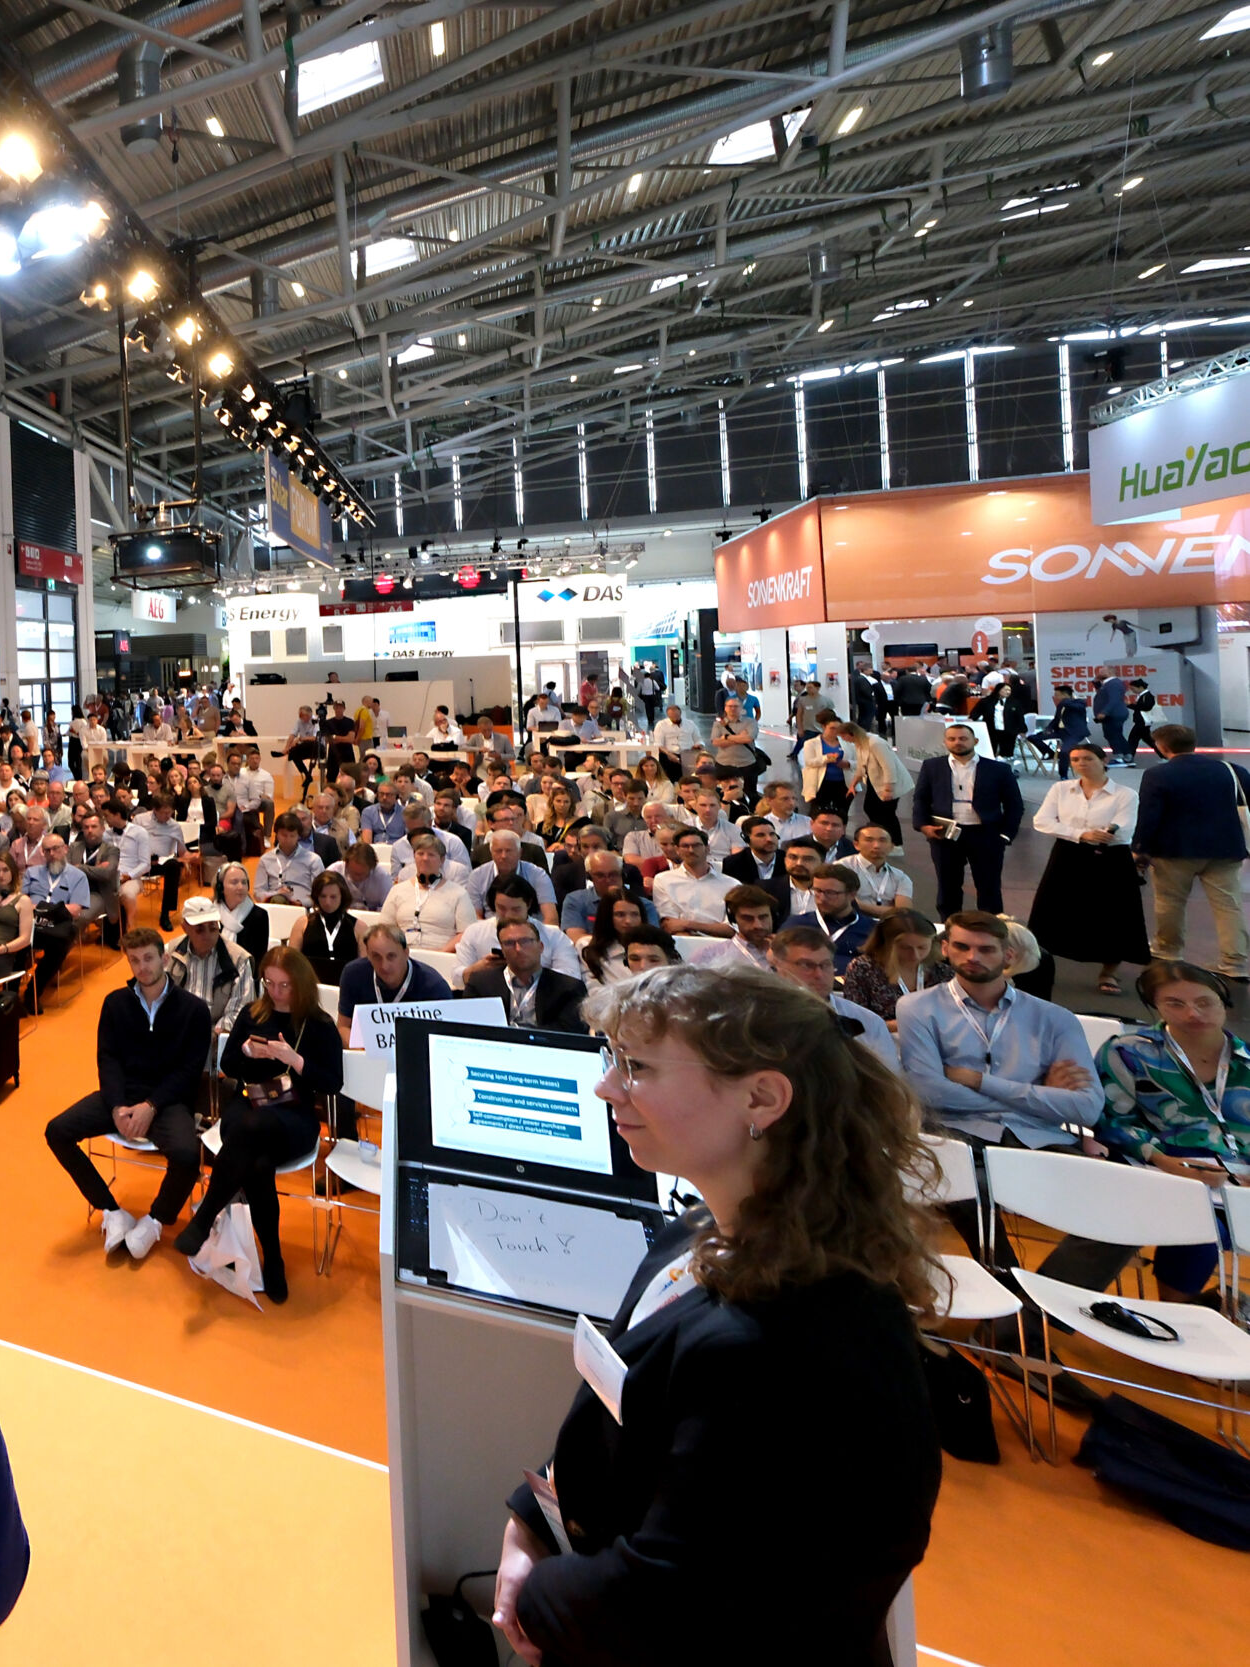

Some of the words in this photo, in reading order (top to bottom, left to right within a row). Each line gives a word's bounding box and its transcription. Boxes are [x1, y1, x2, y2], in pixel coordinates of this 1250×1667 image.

[582, 585, 624, 602] DAS
[747, 565, 813, 608] SONNENKRAFT
[148, 597, 164, 620] AEG
[239, 606, 300, 622] Energy
[392, 649, 415, 658] DAS
[418, 648, 455, 658] Energy
[477, 1093, 514, 1104] Construction
[514, 1098, 526, 1106] and
[526, 1100, 549, 1109] services
[550, 1103, 578, 1114] contracts
[486, 1232, 549, 1255] Touch
